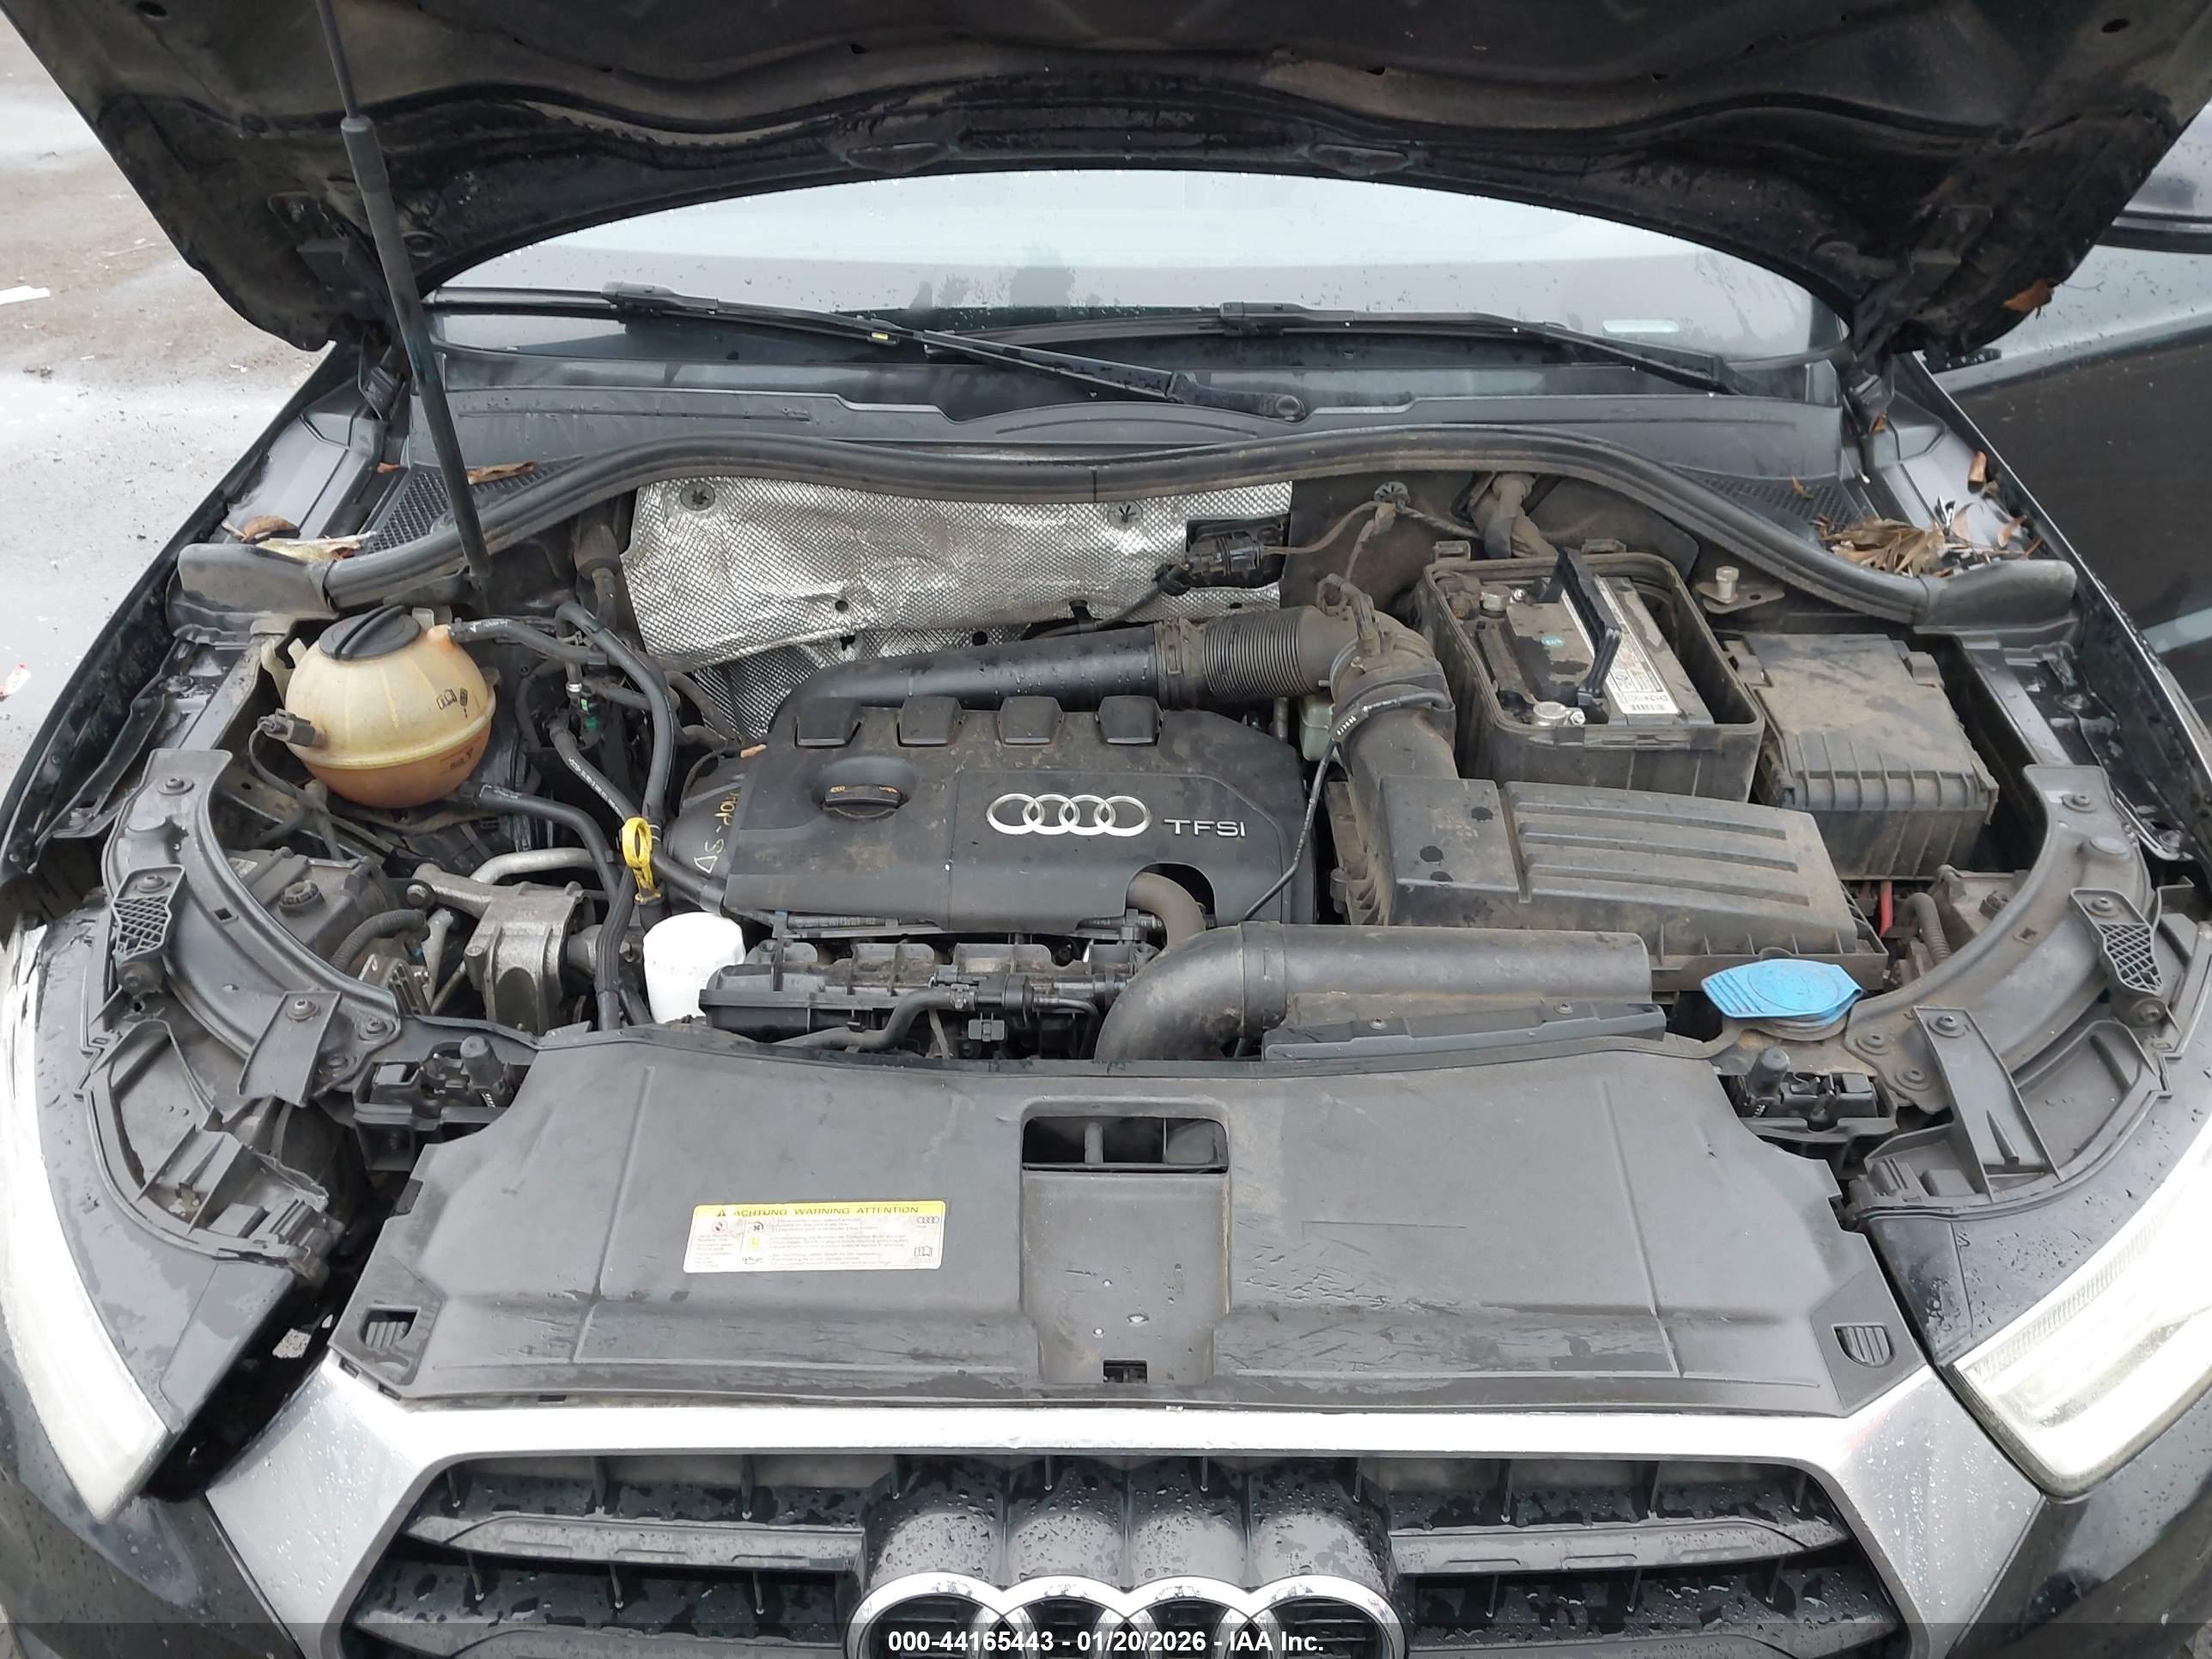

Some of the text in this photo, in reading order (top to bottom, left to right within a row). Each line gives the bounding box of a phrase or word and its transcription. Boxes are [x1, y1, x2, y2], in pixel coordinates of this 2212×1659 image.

[1164, 818, 1245, 836] TFSI
[734, 1208, 787, 1217] ACHTUNG
[856, 1206, 919, 1214] ATTENTION
